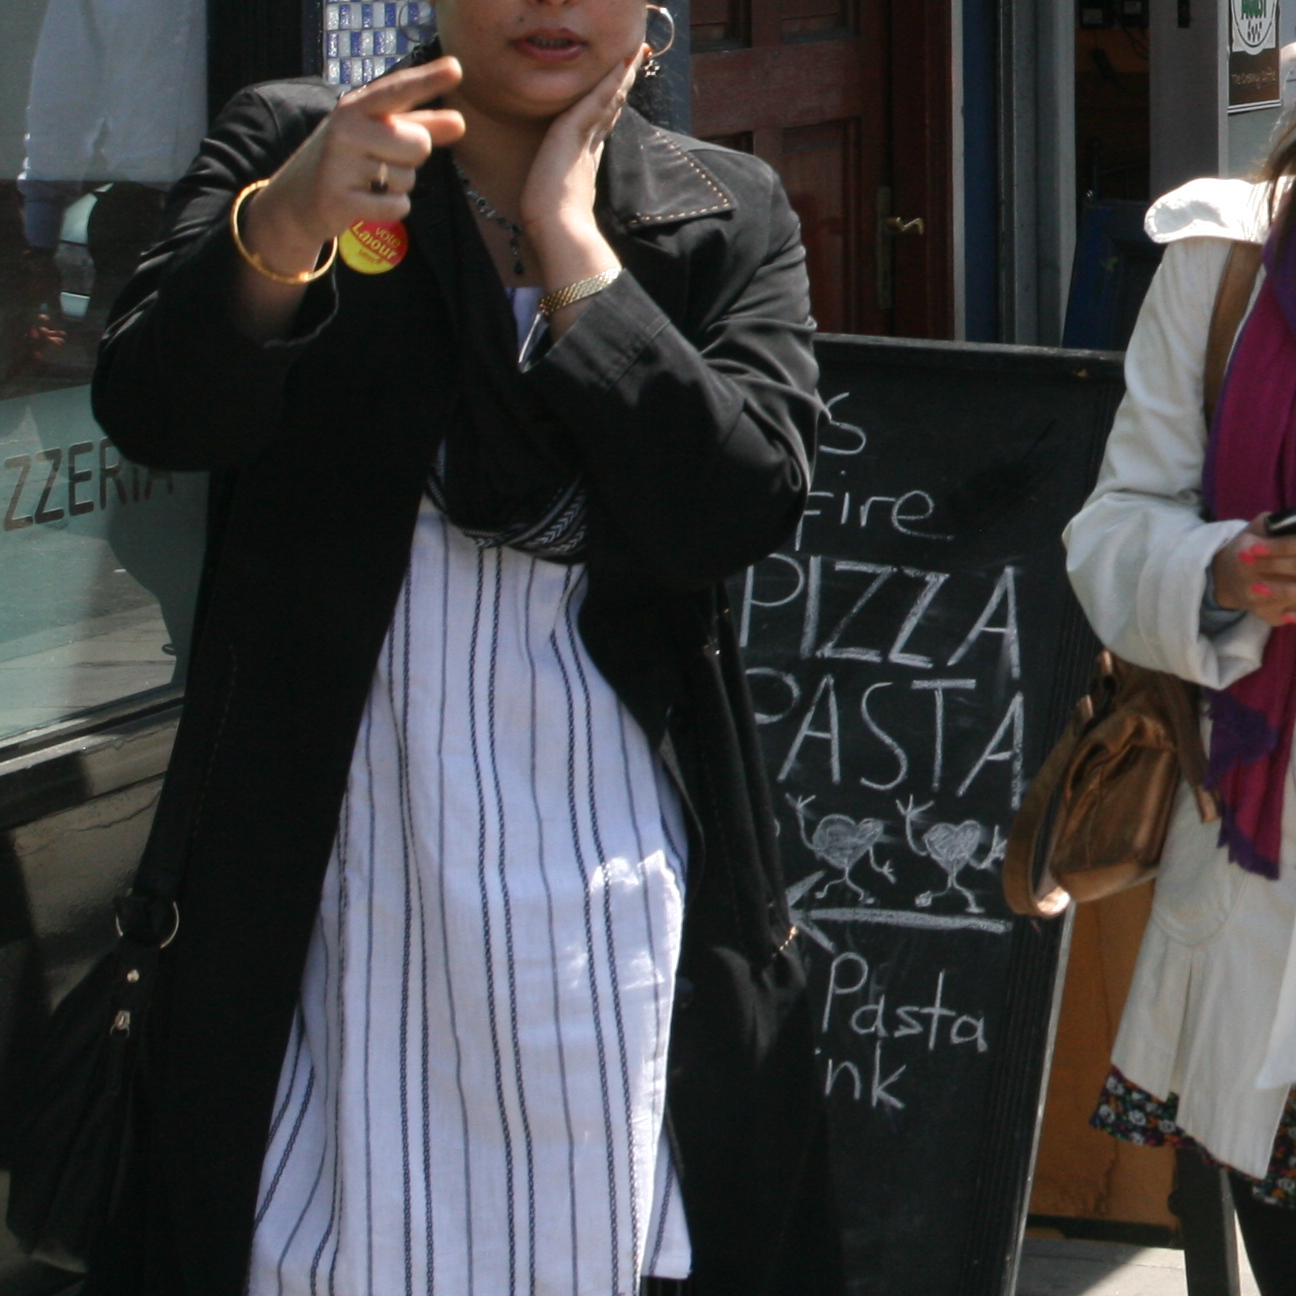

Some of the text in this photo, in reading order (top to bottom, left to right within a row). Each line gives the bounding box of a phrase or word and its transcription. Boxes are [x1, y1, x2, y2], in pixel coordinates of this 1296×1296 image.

[794, 469, 955, 552] Fire
[739, 552, 1023, 680] PIZZA
[744, 666, 1025, 812] PASTA
[820, 951, 989, 1054] Pasta
[814, 1040, 907, 1109] nk
